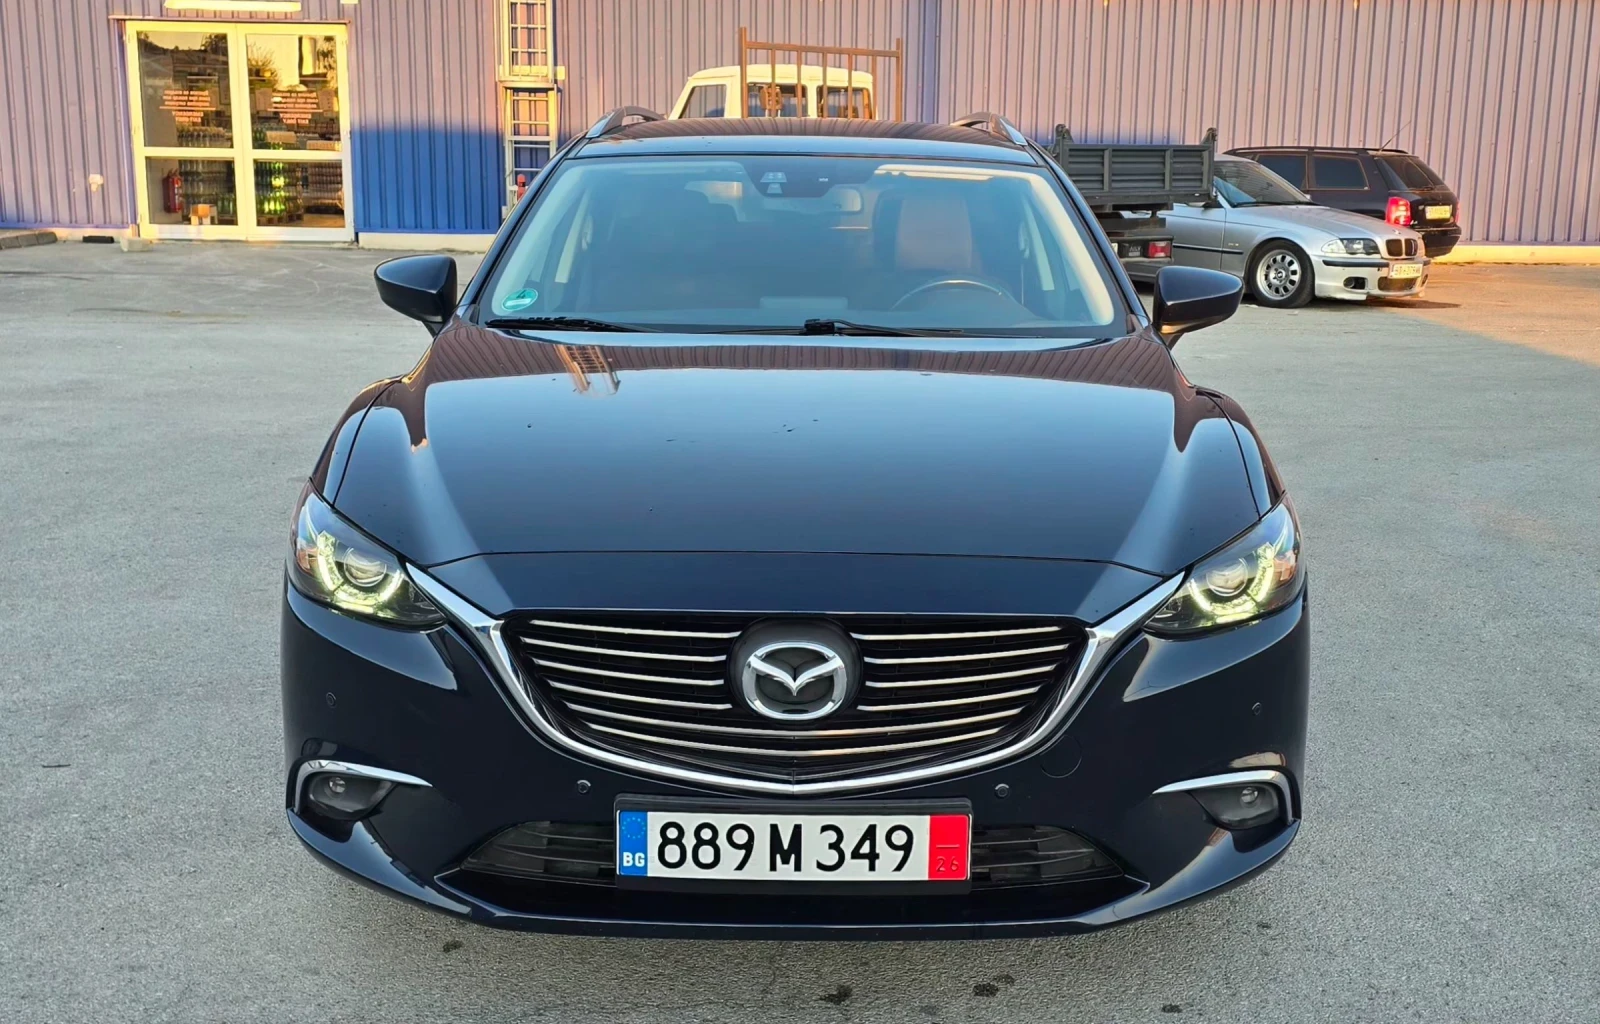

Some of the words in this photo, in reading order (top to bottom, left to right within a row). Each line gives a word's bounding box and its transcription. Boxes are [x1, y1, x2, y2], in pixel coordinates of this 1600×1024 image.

[657, 821, 755, 871] 889
[769, 823, 802, 872] M
[816, 823, 914, 873] 349
[623, 851, 645, 867] BG
[936, 856, 960, 873] 26
